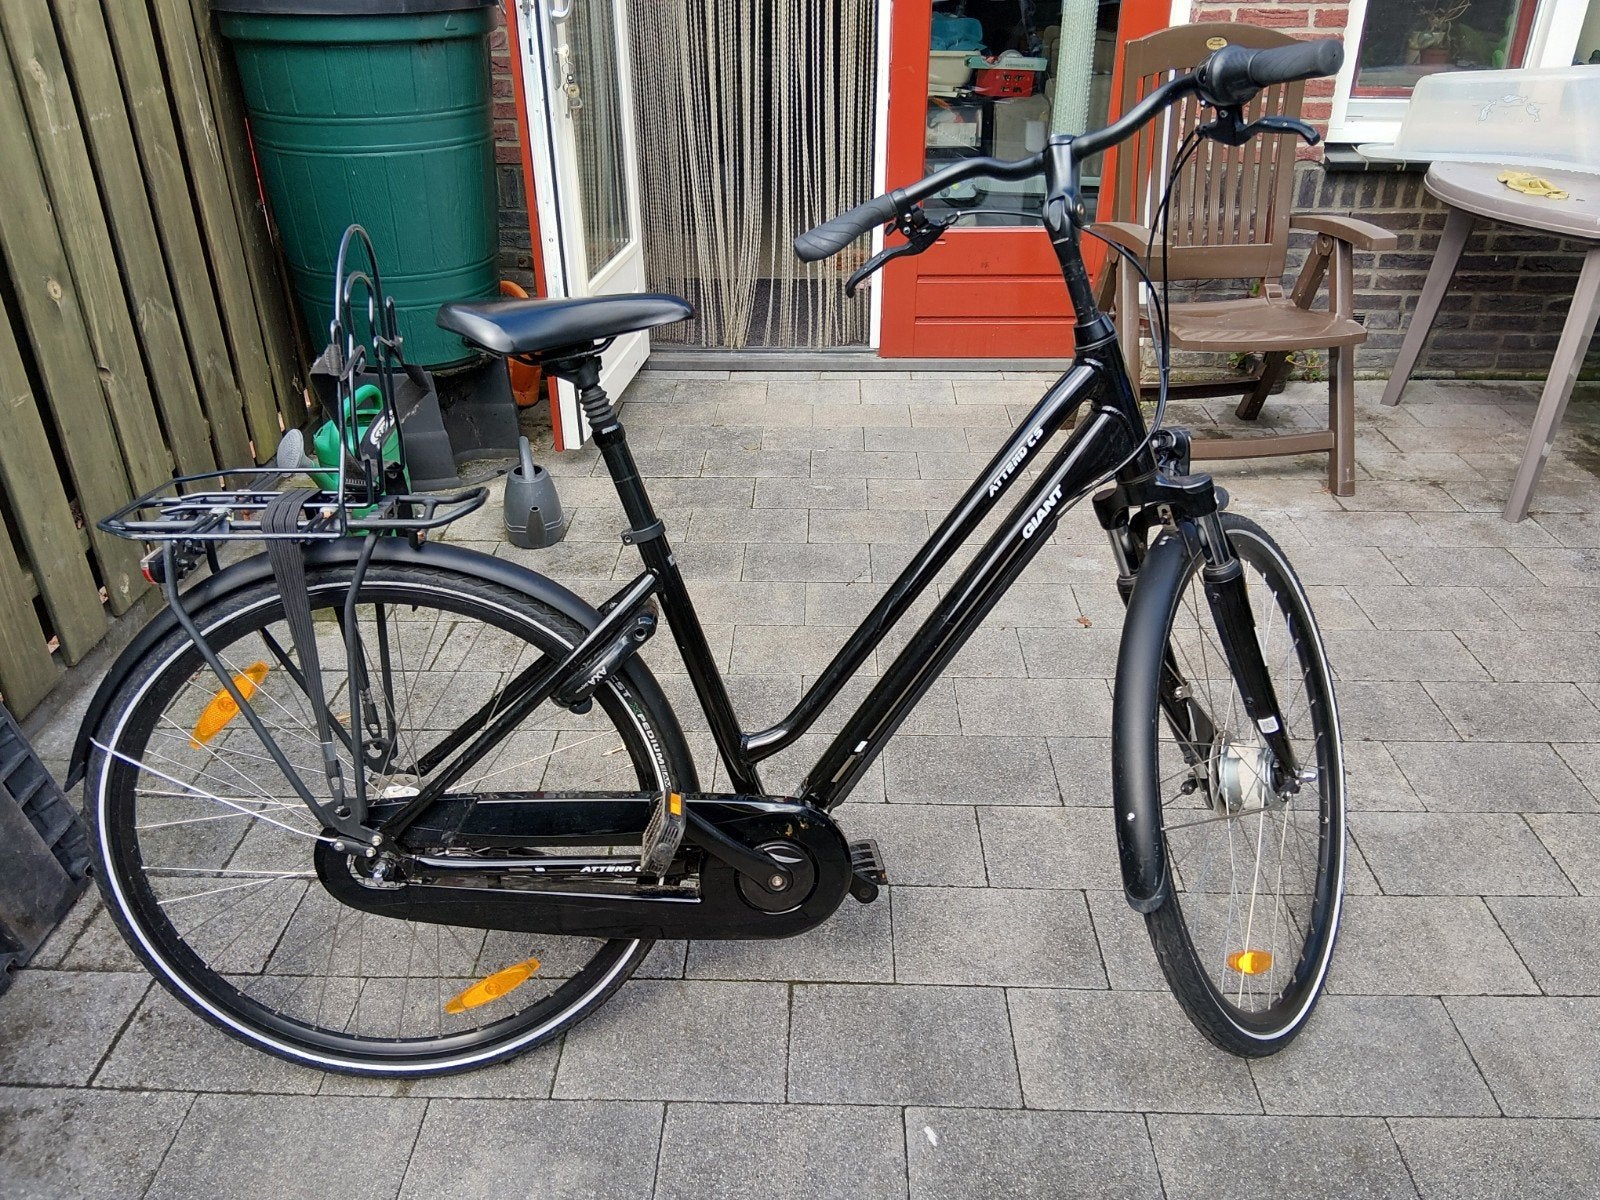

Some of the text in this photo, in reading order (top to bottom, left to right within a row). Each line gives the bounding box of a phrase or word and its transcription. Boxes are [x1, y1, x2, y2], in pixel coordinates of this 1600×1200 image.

[988, 446, 1028, 498] ATTEND
[1022, 484, 1063, 539] GIANT
[587, 666, 608, 686] AXA
[580, 865, 633, 873] ATTEND
